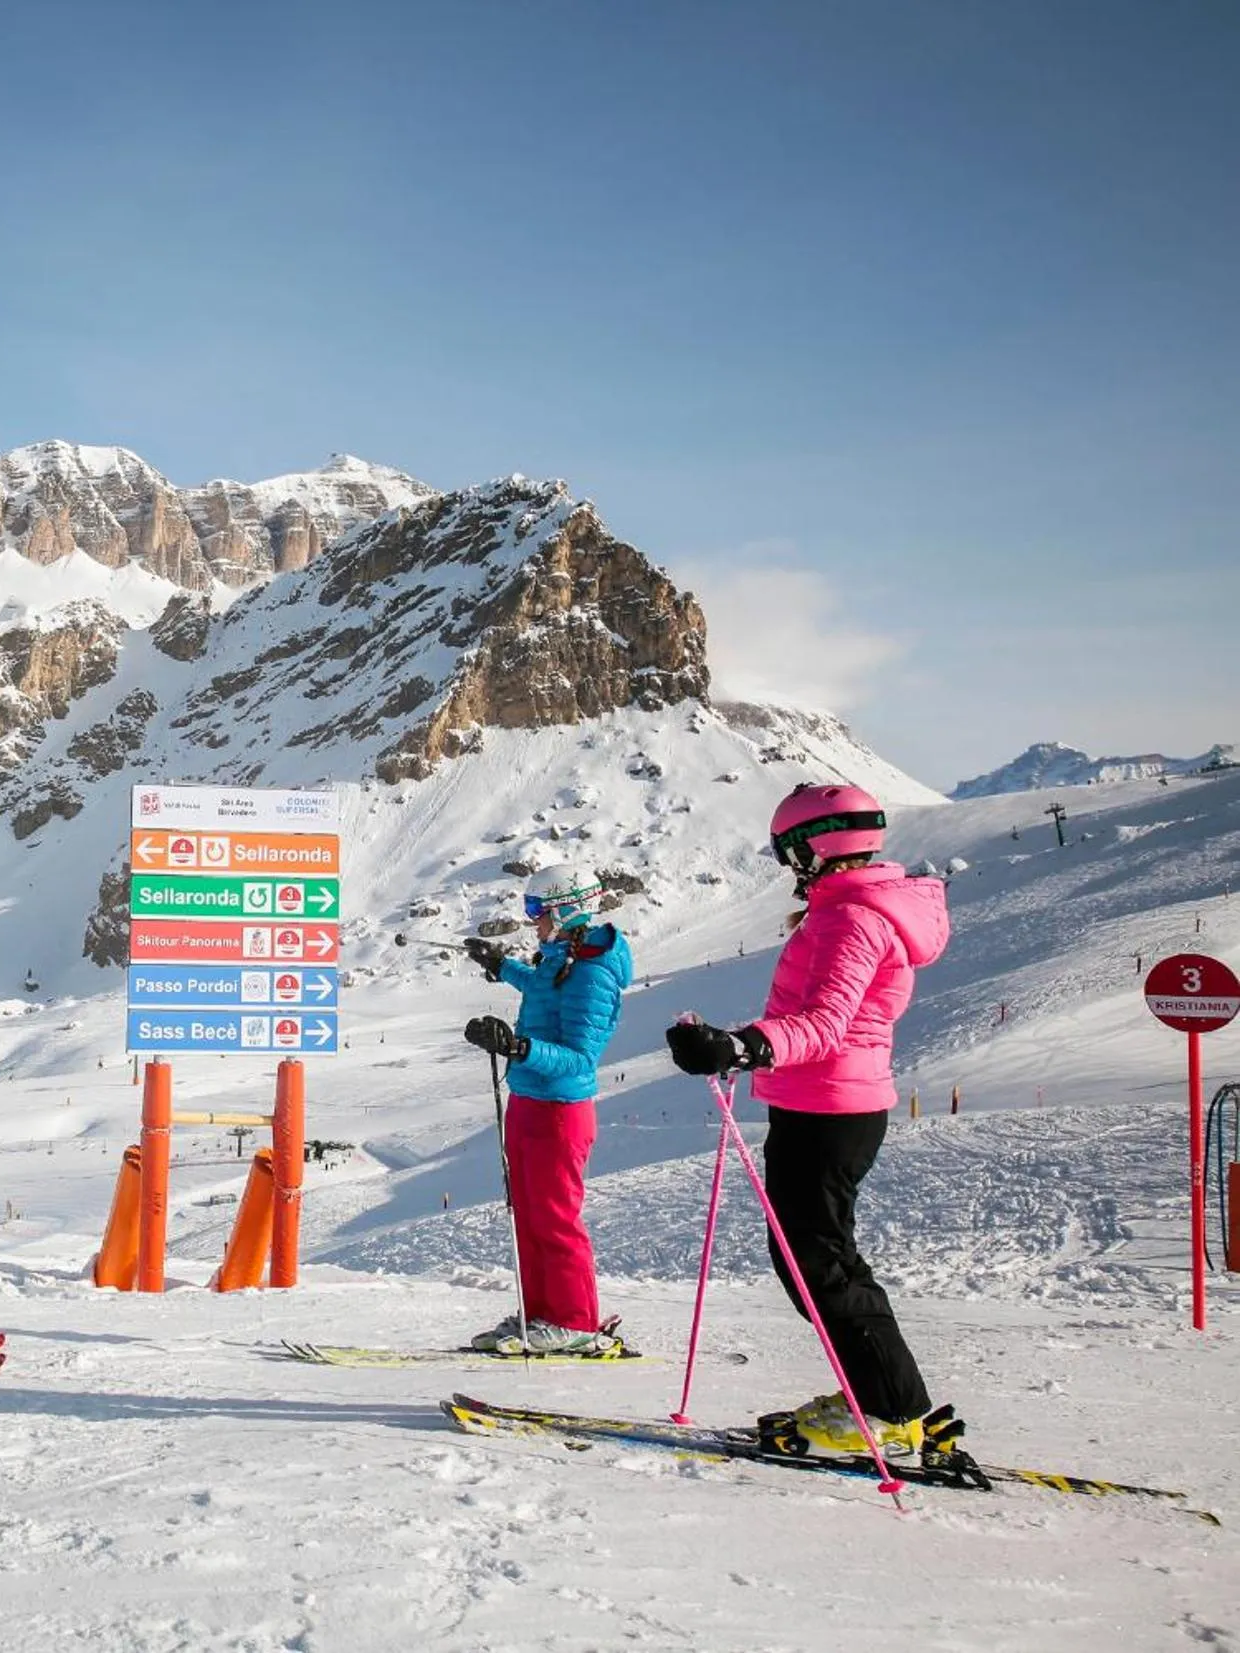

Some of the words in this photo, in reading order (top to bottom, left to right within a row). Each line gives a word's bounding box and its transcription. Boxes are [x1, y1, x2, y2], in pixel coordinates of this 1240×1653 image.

[179, 841, 187, 851] 4
[234, 844, 331, 863] Sellaronda
[139, 885, 240, 906] Sellaronda
[286, 888, 294, 900] 3
[136, 934, 178, 947] Skitour
[183, 934, 240, 948] Panorama
[285, 933, 292, 943] 3
[135, 977, 183, 993] Passo
[188, 977, 238, 993] Pordoi
[284, 977, 292, 988] 3
[1182, 967, 1202, 993] 3
[1155, 1001, 1230, 1012] KRISTIANIA
[139, 1022, 185, 1040] Sass
[191, 1021, 238, 1041] Becè
[284, 1023, 291, 1034] 3
